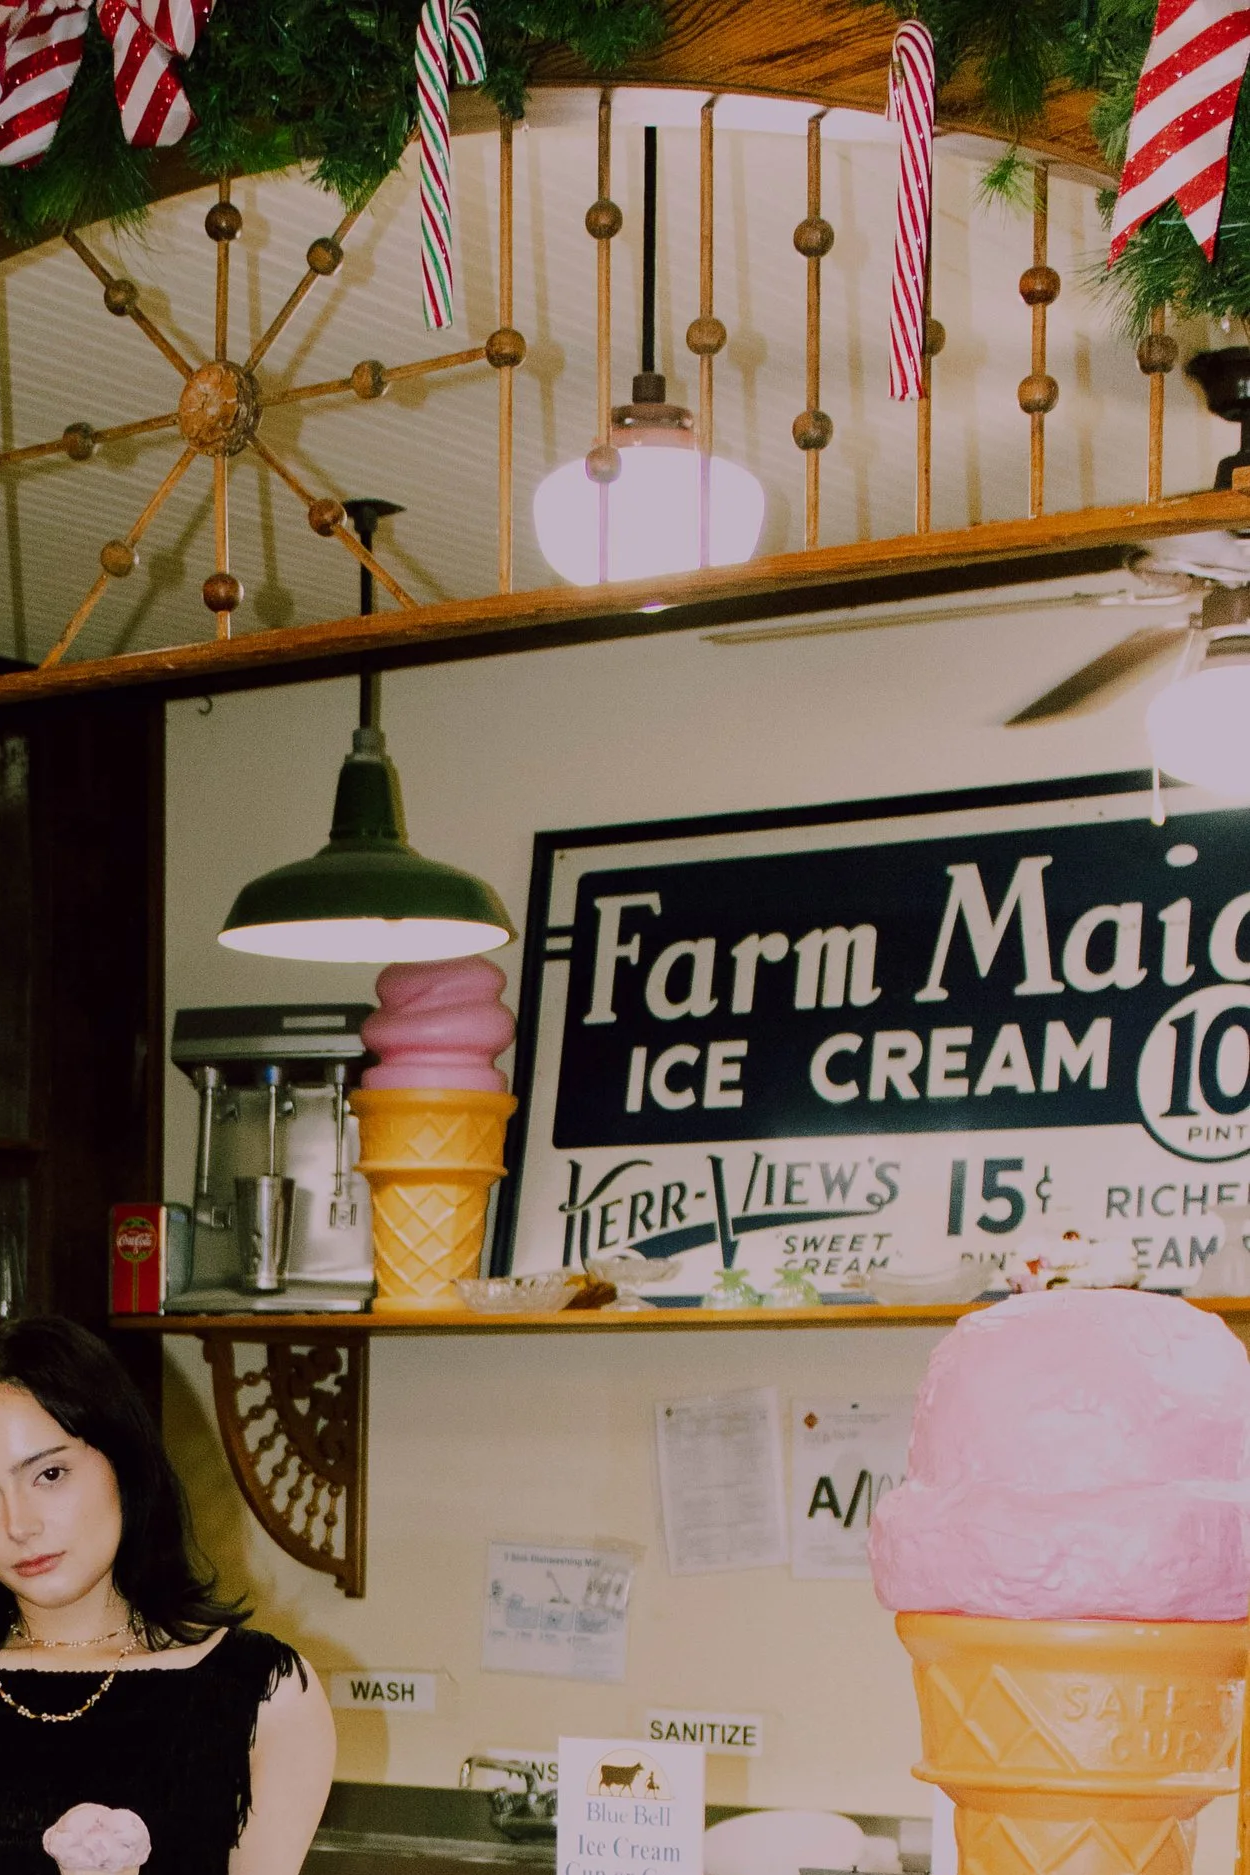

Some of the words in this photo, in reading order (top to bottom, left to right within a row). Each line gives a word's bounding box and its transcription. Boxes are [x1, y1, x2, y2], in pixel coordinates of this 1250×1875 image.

[583, 892, 882, 1025] Farm
[625, 1040, 748, 1113] ICE
[809, 1017, 1112, 1104] CREAM
[351, 1681, 415, 1702] WASH
[650, 1719, 758, 1747] SANITIZE
[586, 1801, 629, 1824] Blue
[634, 1804, 671, 1827] Bell
[578, 1834, 607, 1857] Ice
[613, 1836, 681, 1862] Cream
